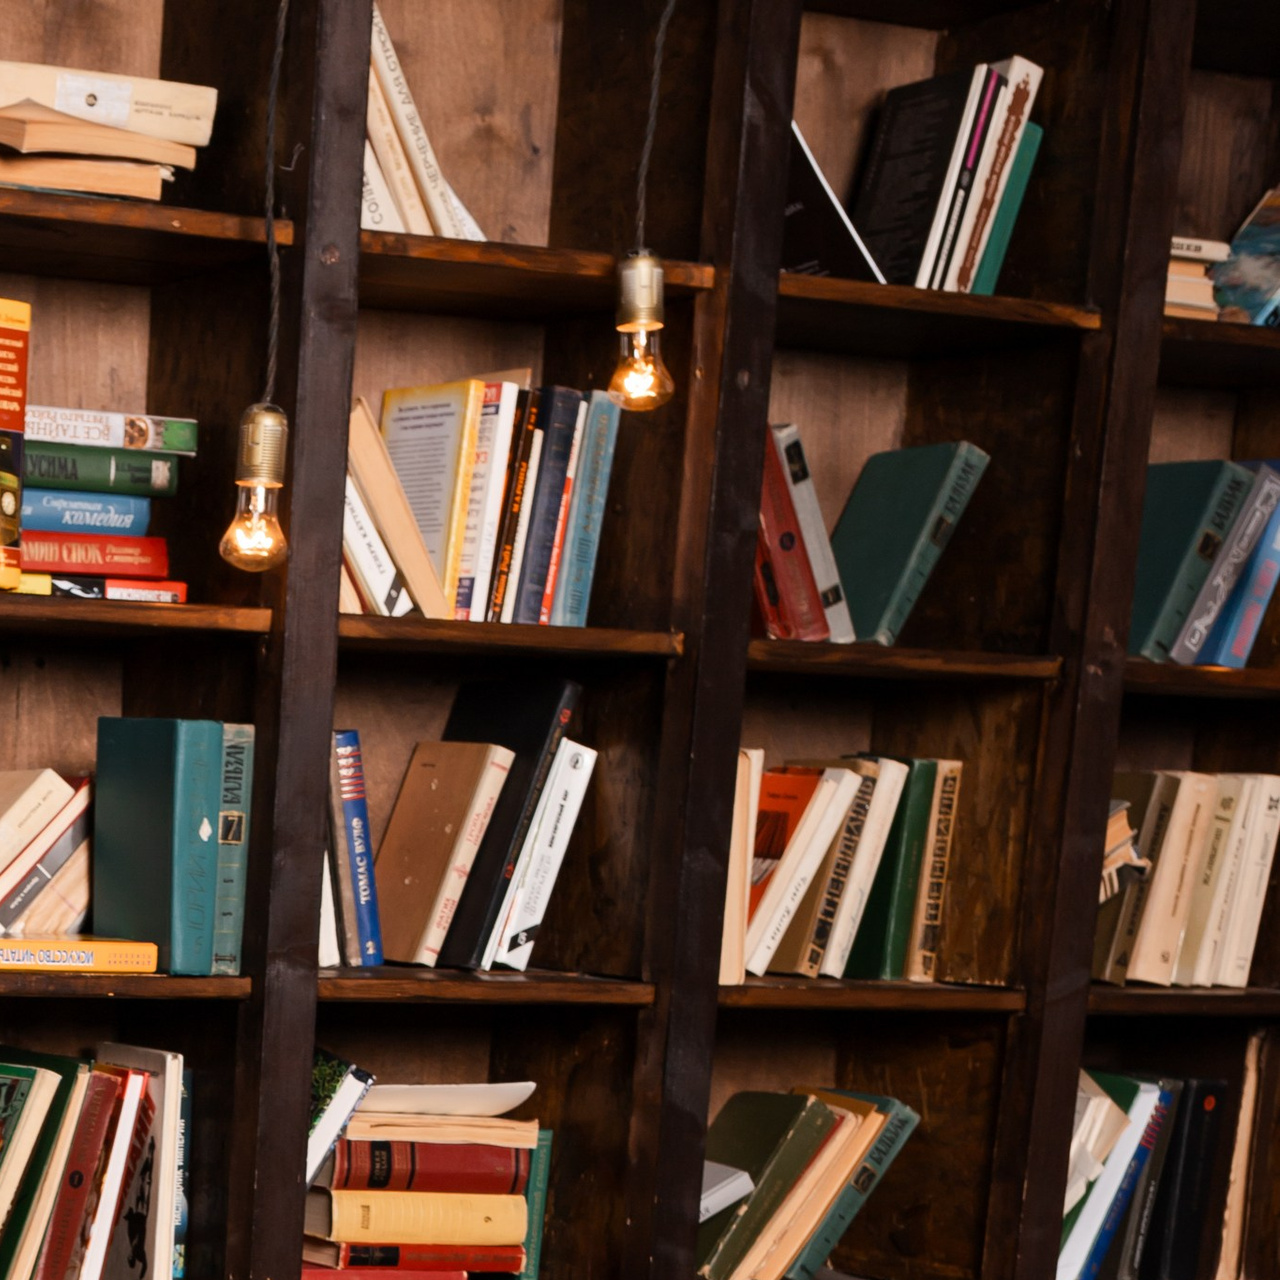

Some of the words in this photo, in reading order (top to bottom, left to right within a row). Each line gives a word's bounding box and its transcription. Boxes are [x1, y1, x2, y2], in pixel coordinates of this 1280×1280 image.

[24, 454, 79, 481] УСИМА
[351, 815, 366, 854] ВУЛФ
[354, 855, 371, 905] ТОМАС
[36, 947, 95, 967] ИСКУССТВО
